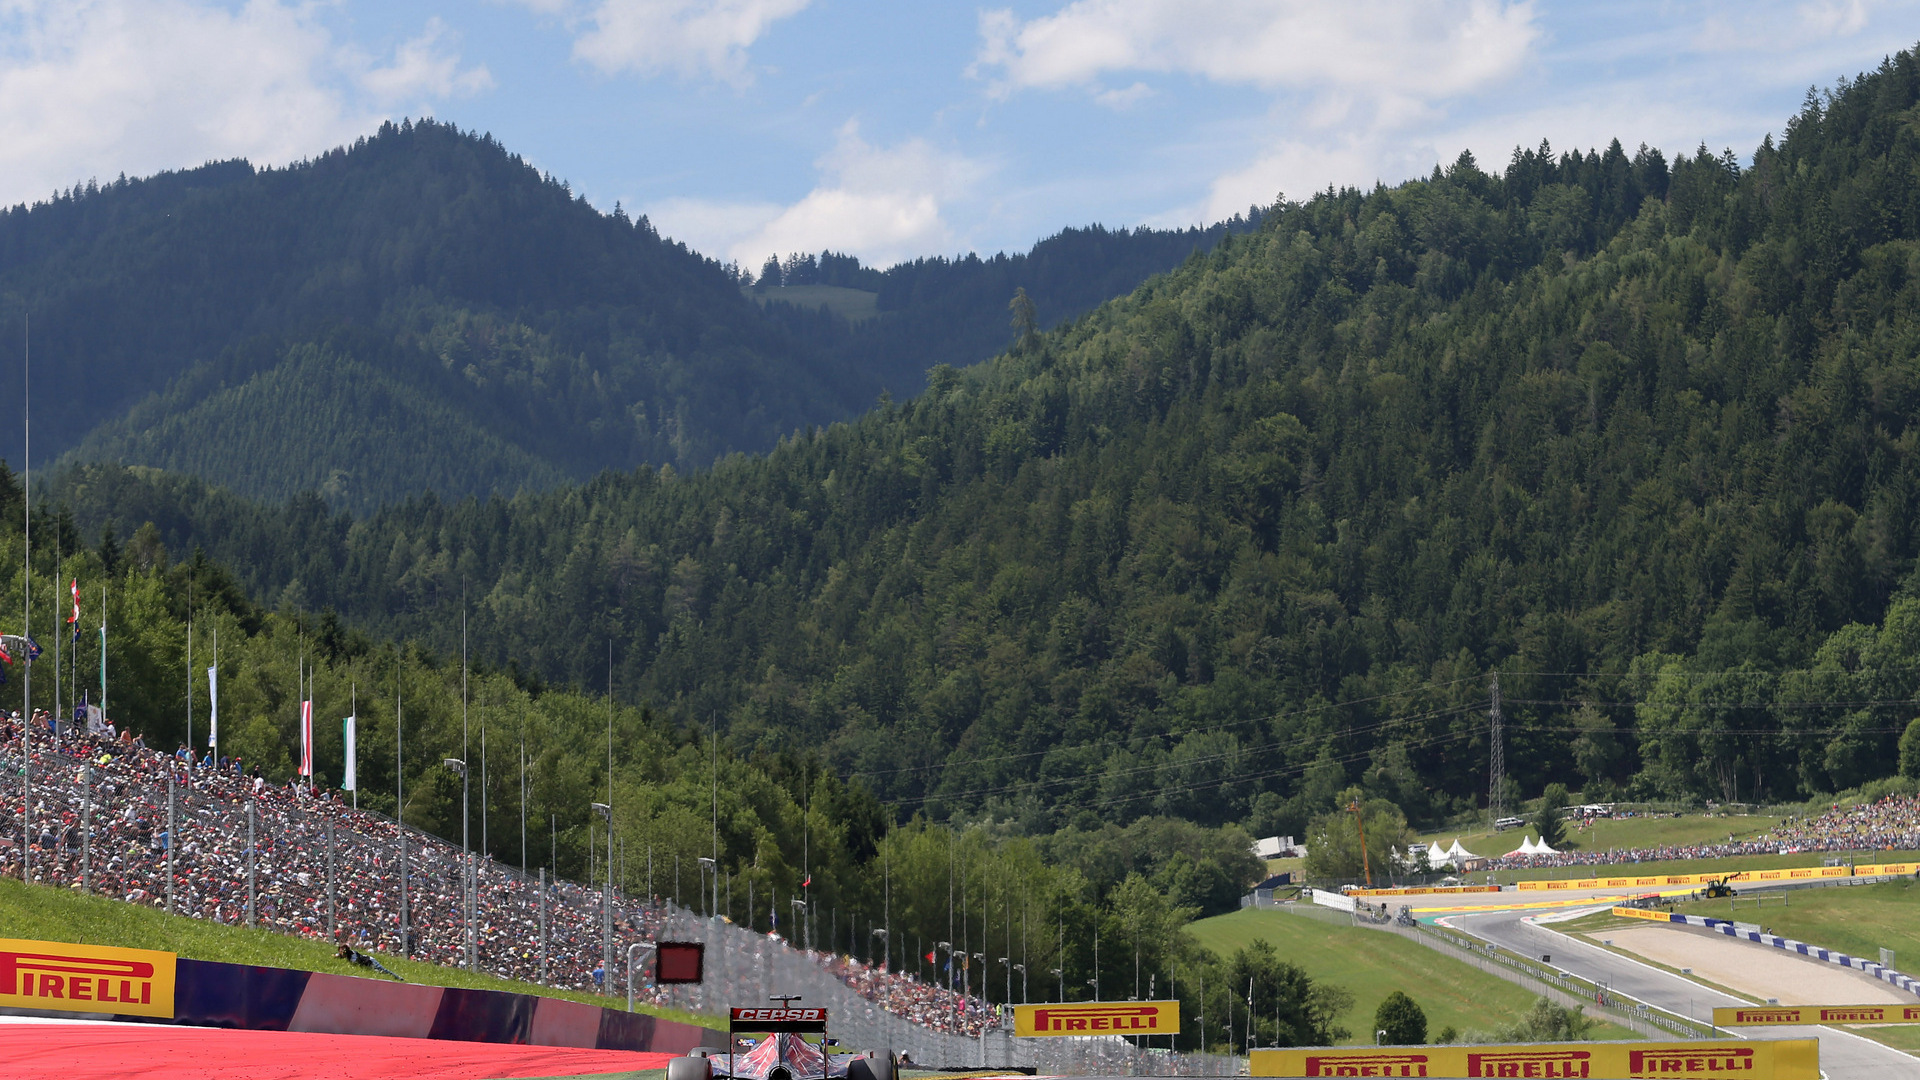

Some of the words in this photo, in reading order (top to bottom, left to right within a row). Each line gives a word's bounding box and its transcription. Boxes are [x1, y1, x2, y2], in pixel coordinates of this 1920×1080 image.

[0, 951, 154, 1004] PIRELLI
[738, 1009, 820, 1020] CEPSA
[1035, 1007, 1159, 1031] PIRELLI
[1737, 1011, 1800, 1022] PIRELLI
[1820, 1009, 1884, 1021] PIRELLI
[1468, 1051, 1591, 1078] PIRELLI
[1630, 1048, 1754, 1073] PIRELLI
